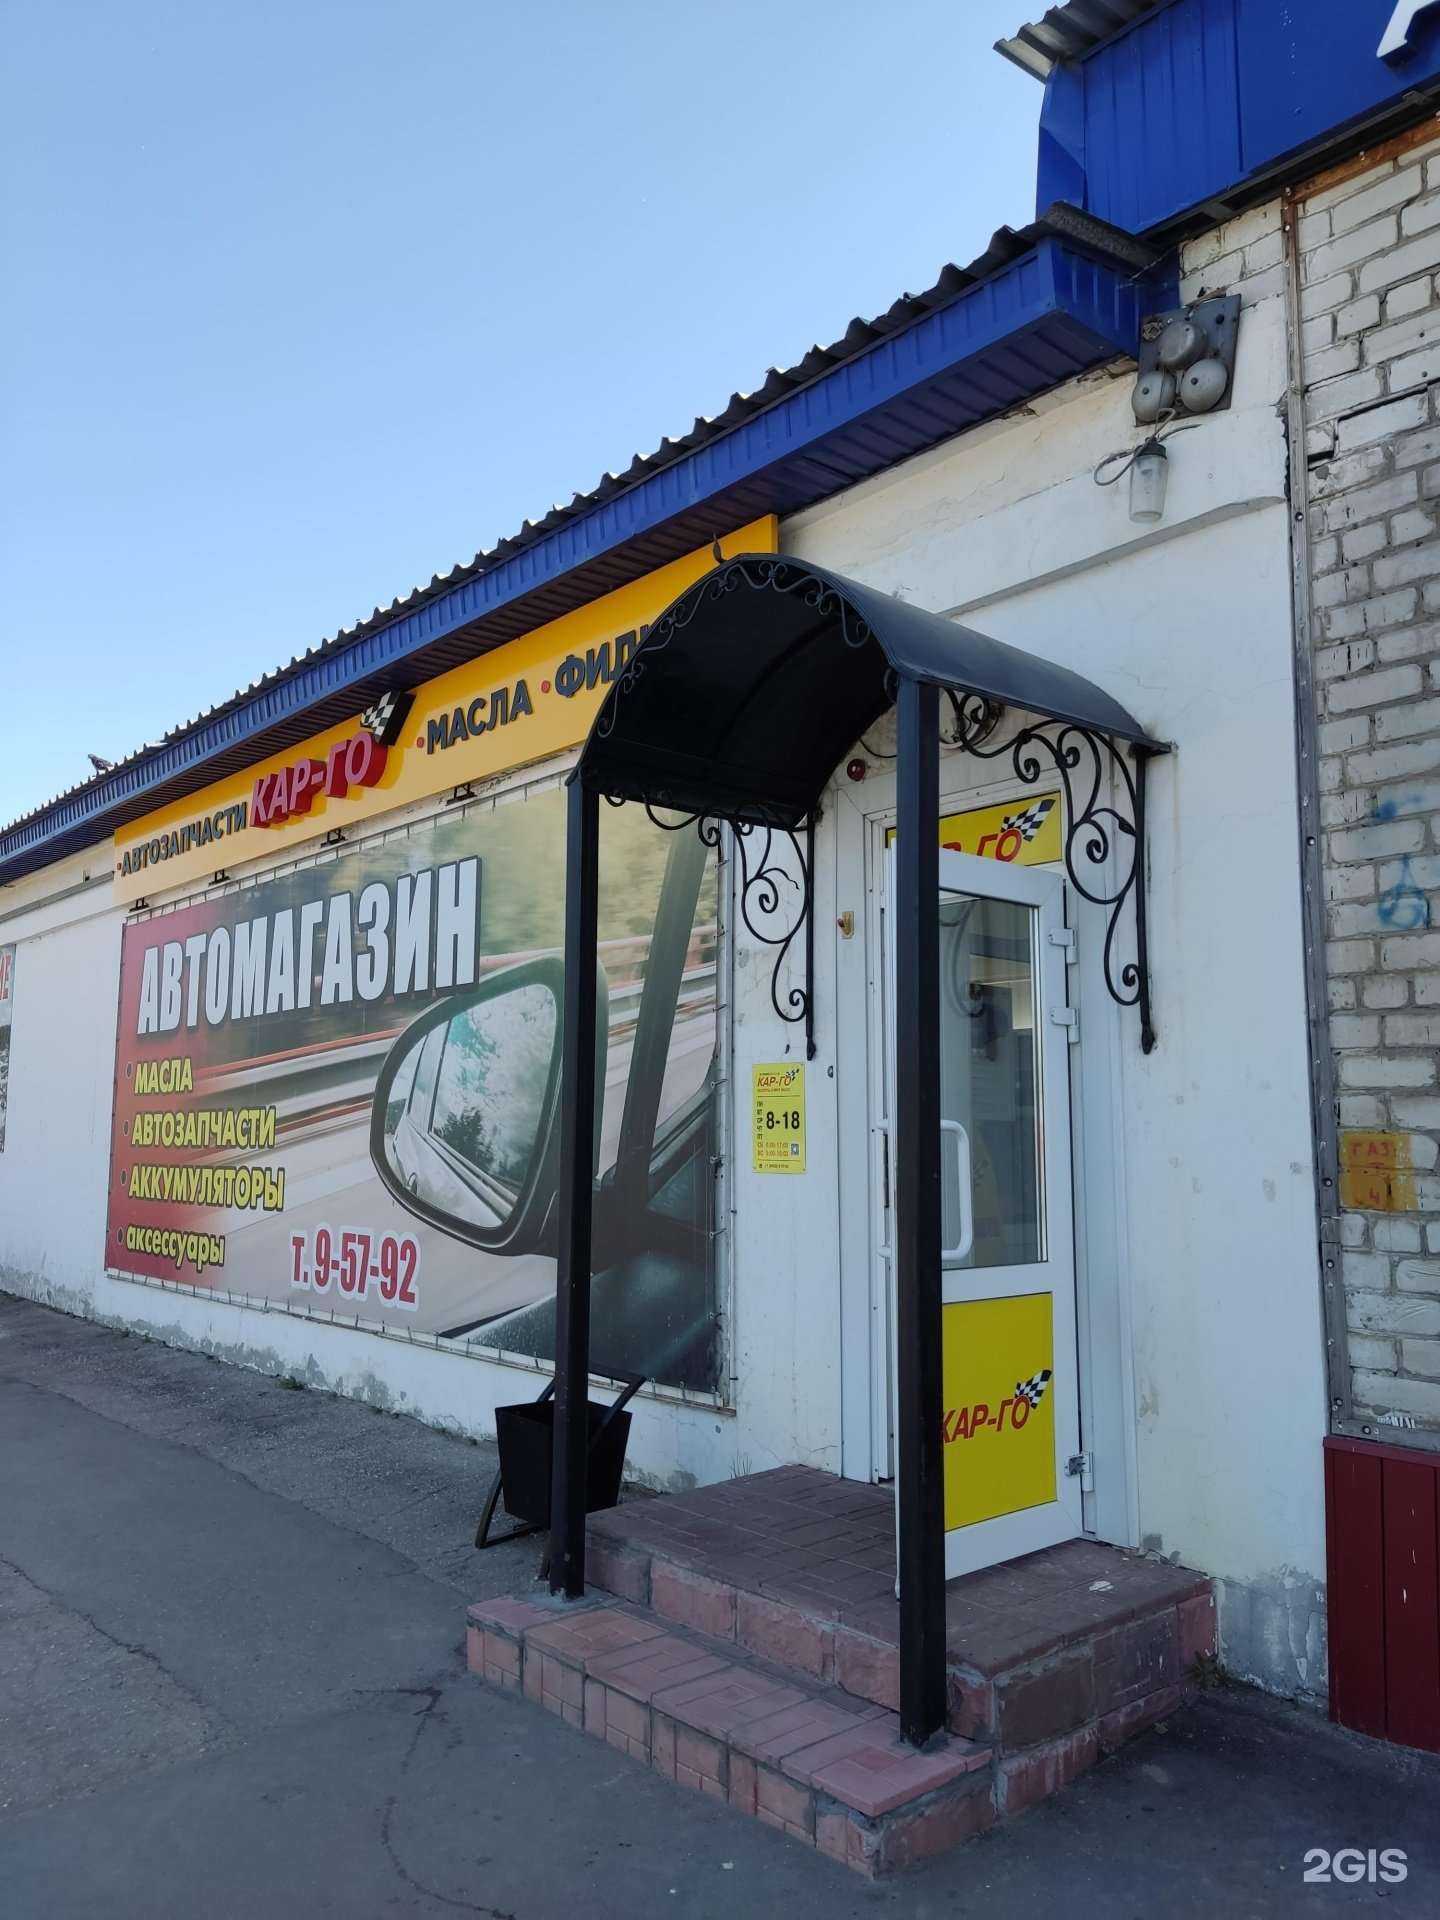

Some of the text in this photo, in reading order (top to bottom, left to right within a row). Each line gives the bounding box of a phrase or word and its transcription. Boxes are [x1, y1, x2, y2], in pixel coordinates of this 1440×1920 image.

[121, 624, 650, 877] АВТОЗАПЧАСТИ КАР-ГО МАСЛА ФИЛ
[136, 857, 479, 1035] АВТОМАГАЗИН
[134, 1057, 193, 1094] МАСЛА
[757, 1075, 792, 1087] КАР-ГО
[131, 1105, 278, 1149] АВТОЗАПЧАСТИ
[766, 1110, 800, 1130] 8-18
[128, 1165, 286, 1212] АККУМУЛЯТОРЫ
[125, 1224, 226, 1273] аксессуары
[314, 1228, 419, 1305] 9-57-92
